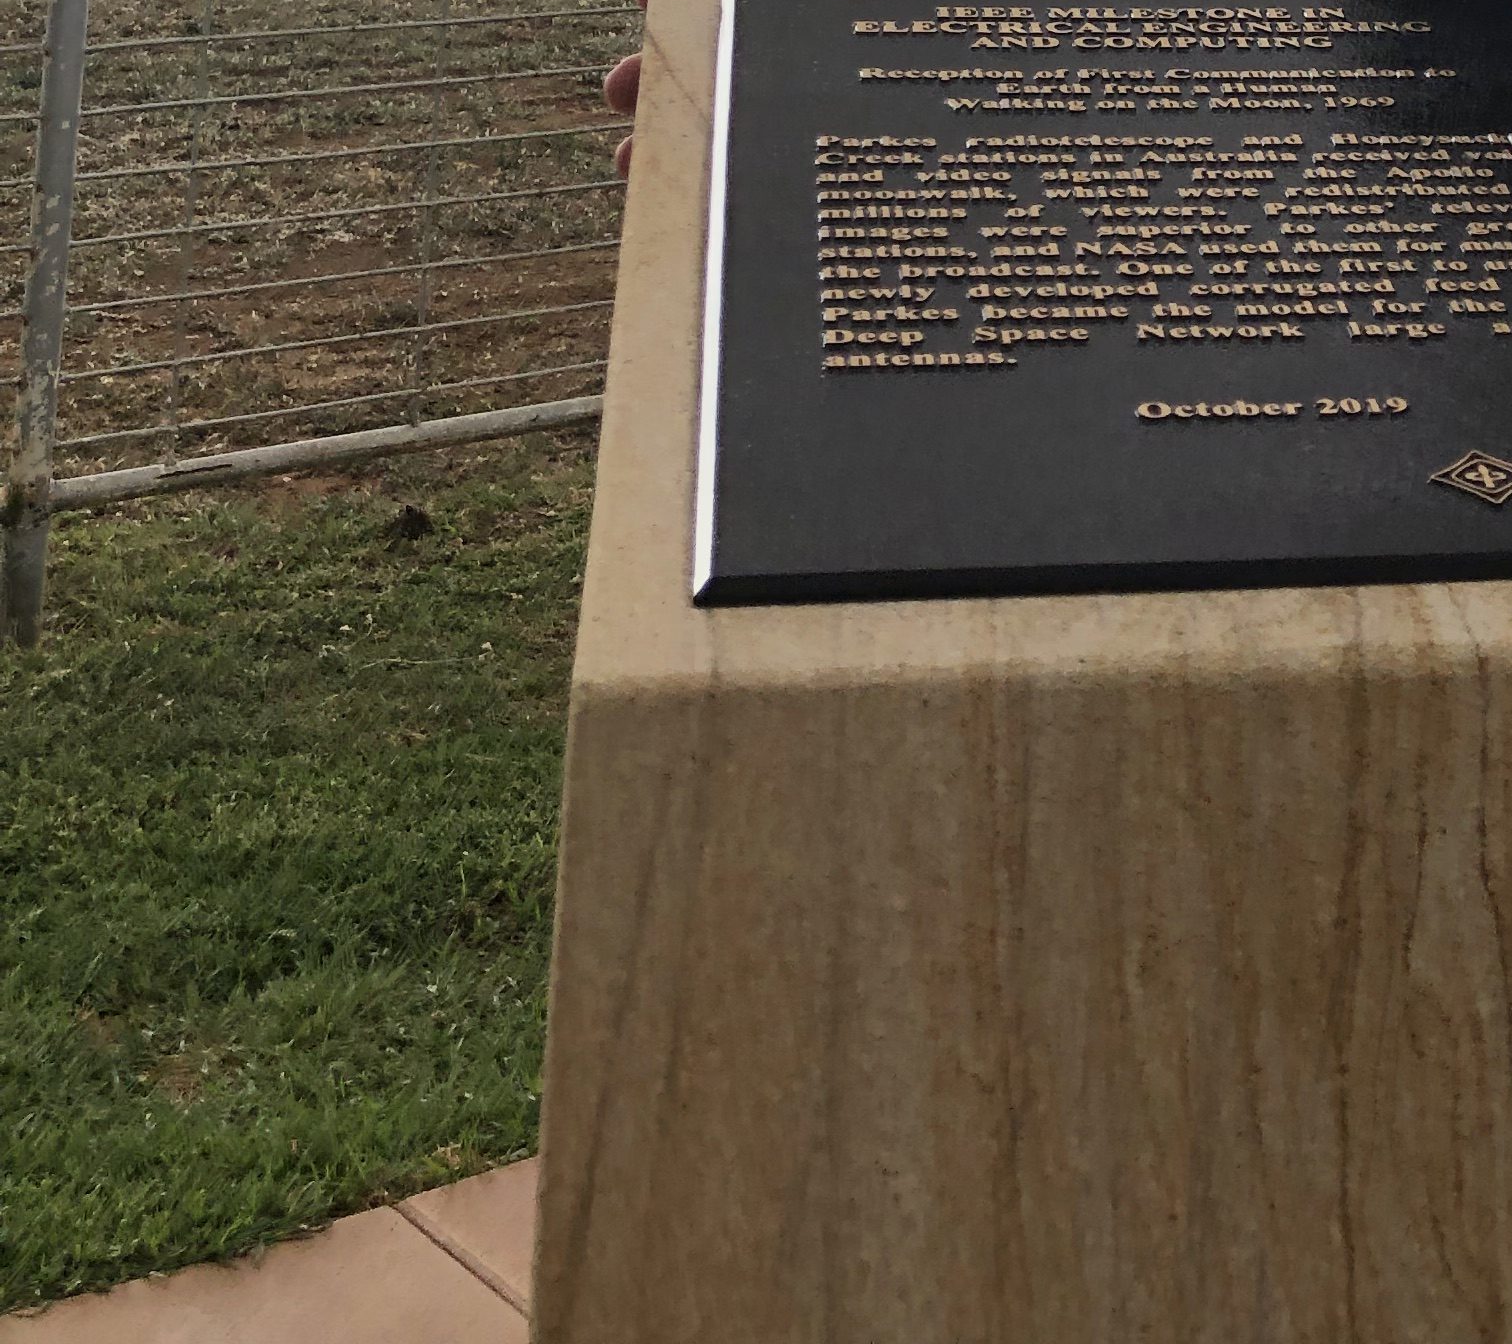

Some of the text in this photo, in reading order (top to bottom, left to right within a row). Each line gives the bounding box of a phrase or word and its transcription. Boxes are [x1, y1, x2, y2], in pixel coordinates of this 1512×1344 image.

[936, 7, 1344, 19] IEEE MILESTONE IN
[852, 20, 1430, 34] ELECTRICAL ENGINEERING
[971, 36, 1332, 48] AND COMPUTING
[859, 67, 1456, 80] Reception of First Communication to
[996, 83, 1336, 95] Earth from a Human
[944, 97, 1394, 110] Walking on the Moon, 1969
[816, 136, 936, 150] Parkes
[966, 135, 1213, 148] radiotelescope
[1241, 134, 1303, 146] and
[813, 152, 924, 165] Creek
[938, 152, 1076, 163] stations
[1090, 151, 1124, 164] in
[1140, 150, 1297, 163] Australia
[1311, 150, 1450, 163] received
[816, 170, 883, 184] and
[914, 169, 1011, 182] video
[1040, 168, 1162, 182] signals
[1191, 168, 1274, 181] from
[1302, 167, 1356, 179] the
[1387, 166, 1493, 182] Apollo
[816, 187, 1016, 203] moonwalk,
[1042, 185, 1148, 198] which
[1175, 188, 1259, 197] were
[1283, 183, 1510, 198] redistributed
[817, 206, 966, 222] millions
[1004, 204, 1044, 217] of
[1079, 204, 1227, 217] viewers.
[817, 226, 950, 241] images
[978, 226, 1067, 237] were
[1097, 222, 1251, 238] superior
[1279, 223, 1315, 234] to
[1343, 220, 1438, 233] other
[817, 245, 978, 260] stations,
[990, 243, 1059, 257] and
[1075, 242, 1187, 257] NASA
[1199, 240, 1280, 255] used
[1292, 240, 1382, 253] them
[1396, 239, 1446, 253] for
[818, 265, 880, 280] the
[898, 263, 1101, 280] broadcast.
[1116, 261, 1193, 275] One
[1209, 260, 1248, 274] of
[1265, 259, 1321, 274] the
[1338, 259, 1417, 273] first
[1432, 260, 1467, 271] to
[820, 285, 935, 303] newly
[966, 282, 1158, 299] developed
[1188, 279, 1395, 296] corrugated
[1426, 278, 1500, 293] feed
[821, 306, 960, 321] Parkes
[981, 304, 1128, 321] became
[1152, 303, 1211, 317] the
[1234, 300, 1348, 316] model
[1372, 299, 1426, 316] for
[1447, 299, 1506, 313] the
[820, 330, 923, 347] Deep
[971, 326, 1088, 343] Space
[1137, 323, 1304, 338] Network
[1347, 322, 1445, 337] large
[821, 352, 1017, 370] antennas.
[1134, 397, 1407, 418] October 2019
